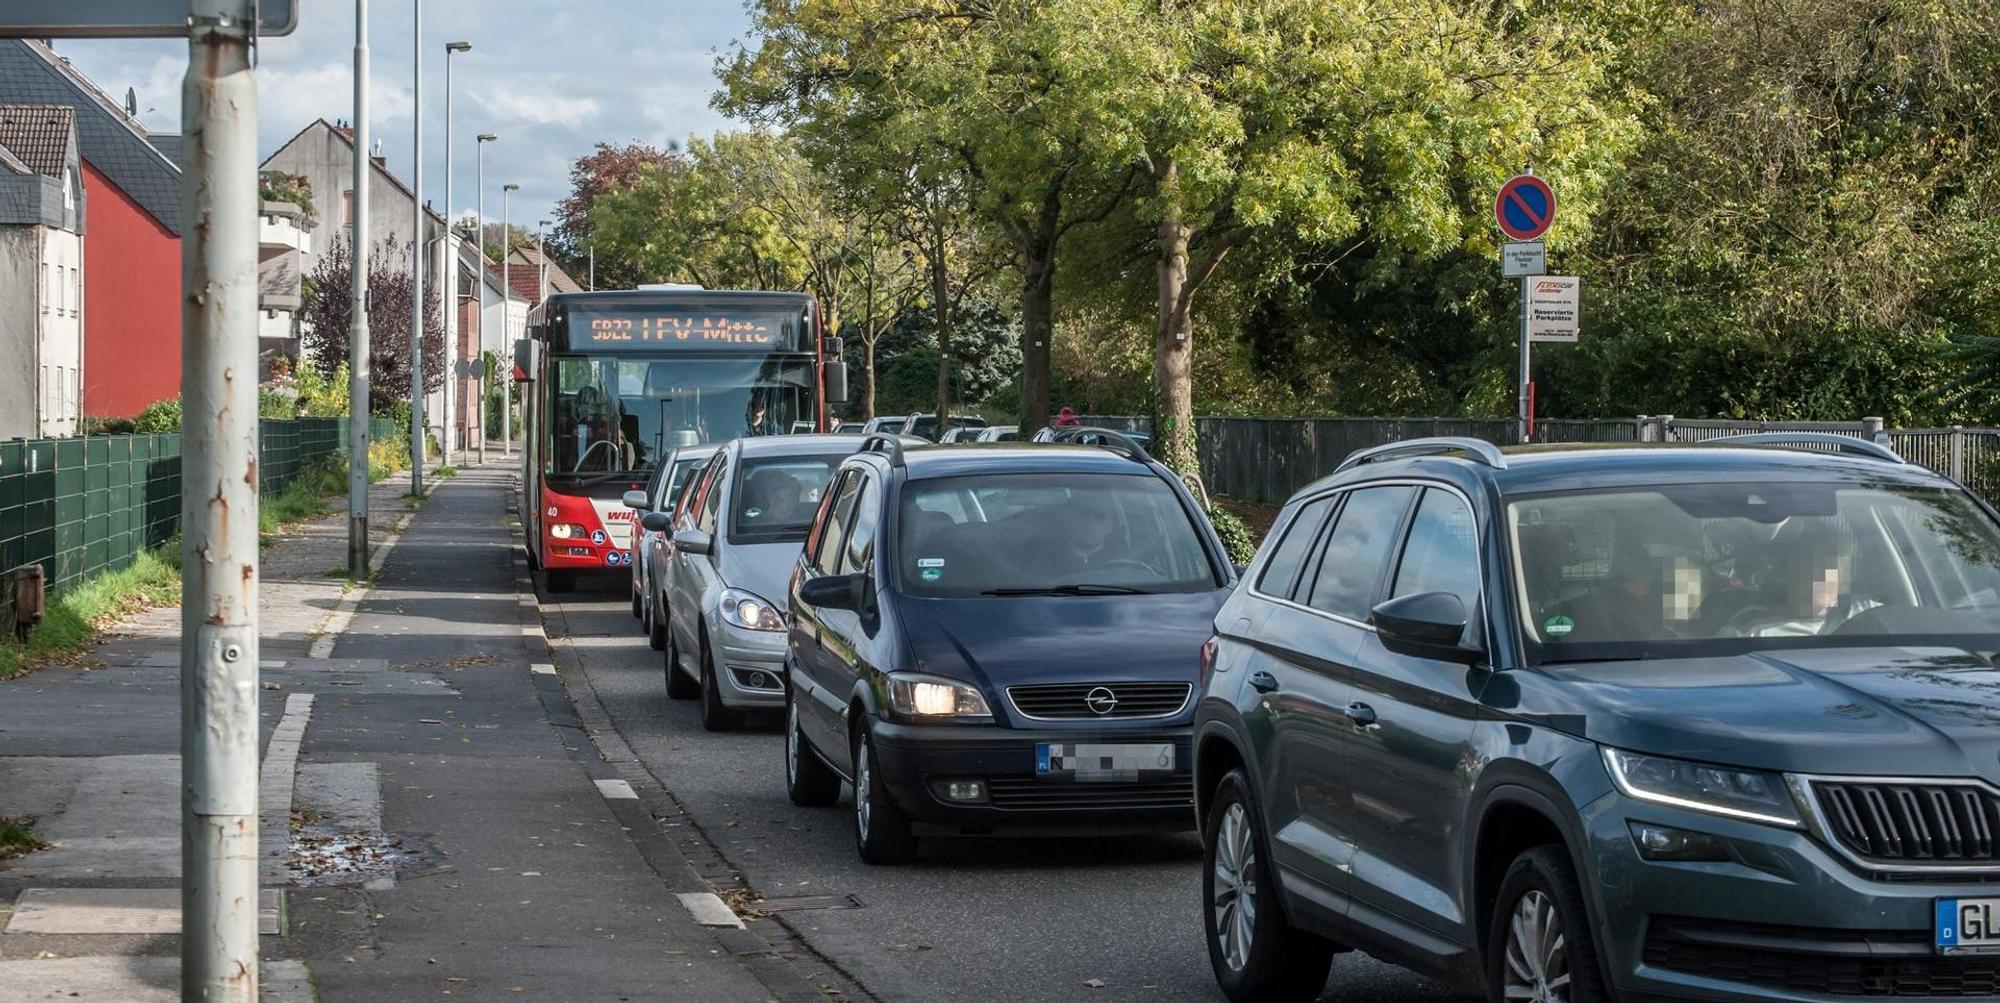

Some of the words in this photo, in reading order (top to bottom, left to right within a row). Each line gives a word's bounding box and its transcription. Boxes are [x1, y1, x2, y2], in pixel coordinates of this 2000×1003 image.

[592, 319, 632, 340] SB22
[547, 507, 558, 517] 40
[1943, 927, 1953, 938] D
